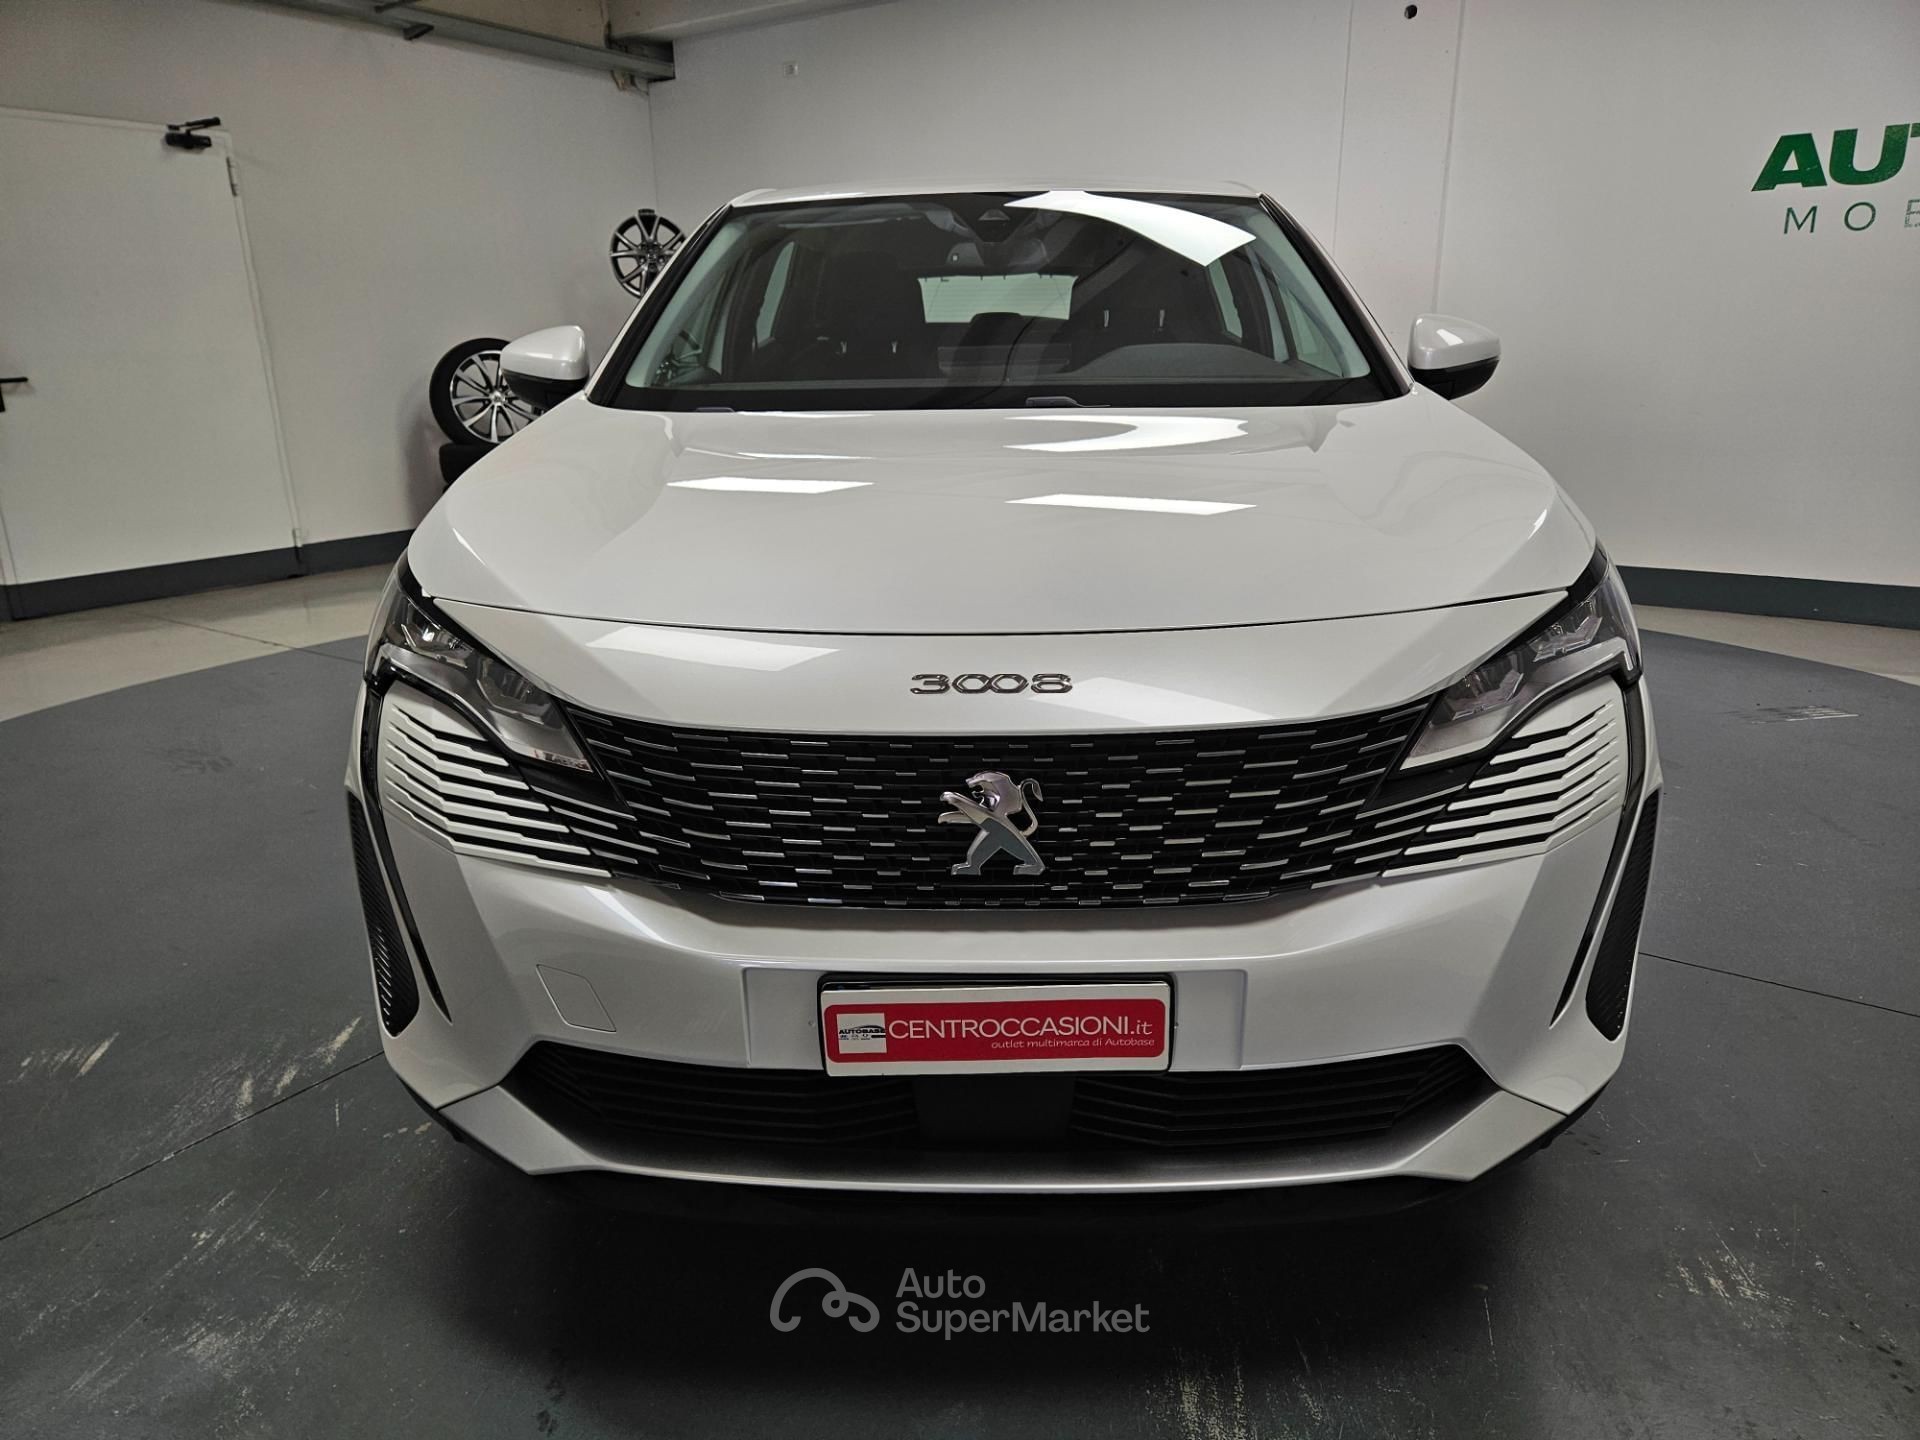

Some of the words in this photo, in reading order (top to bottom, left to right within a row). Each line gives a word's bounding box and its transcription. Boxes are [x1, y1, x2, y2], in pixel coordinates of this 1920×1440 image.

[1751, 122, 1920, 192] AU
[910, 673, 1073, 694] 3008
[888, 1016, 1153, 1039] CENTROCCASIONI.it
[991, 1039, 1025, 1049] outlet
[1027, 1038, 1090, 1048] multimarca
[1092, 1037, 1102, 1047] di
[1105, 1037, 1155, 1047] Autobase
